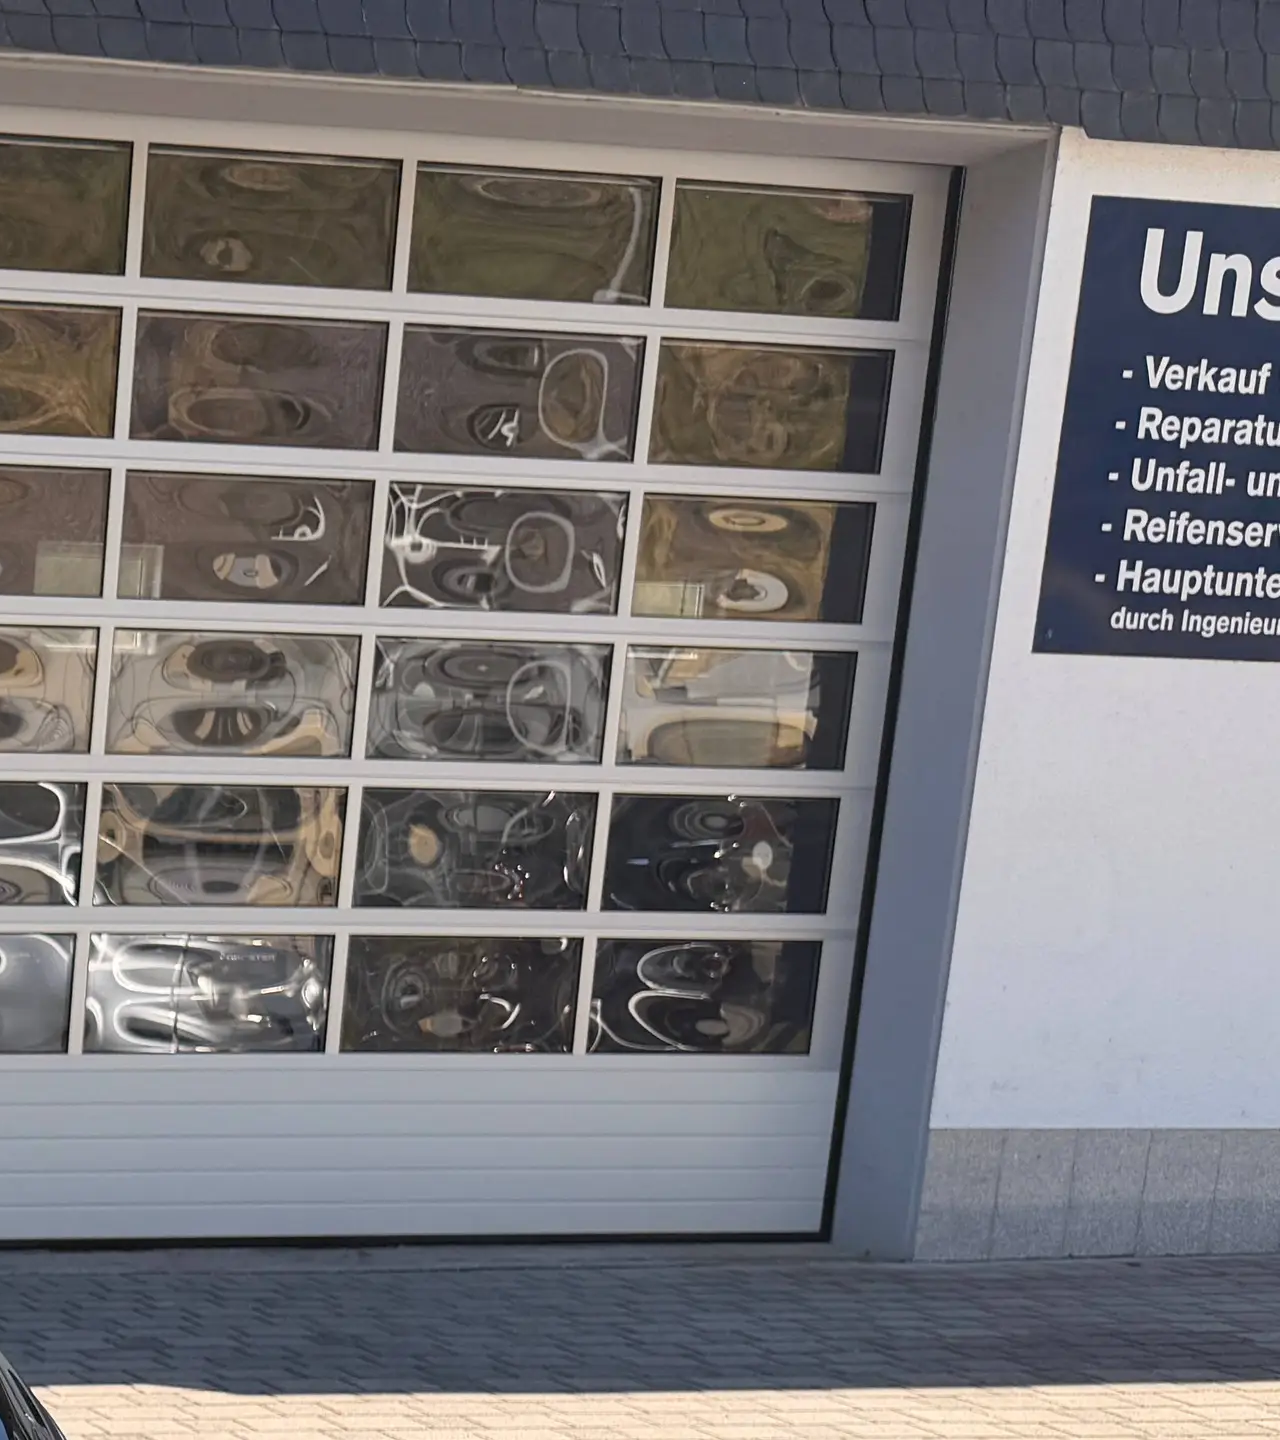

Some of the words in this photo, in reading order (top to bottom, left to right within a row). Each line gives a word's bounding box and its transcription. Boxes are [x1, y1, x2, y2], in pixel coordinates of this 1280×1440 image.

[1146, 355, 1272, 395] Verkauf
[1131, 457, 1236, 495] Unfall-
[1123, 508, 1280, 547] Reifenser
[1110, 606, 1174, 631] durch
